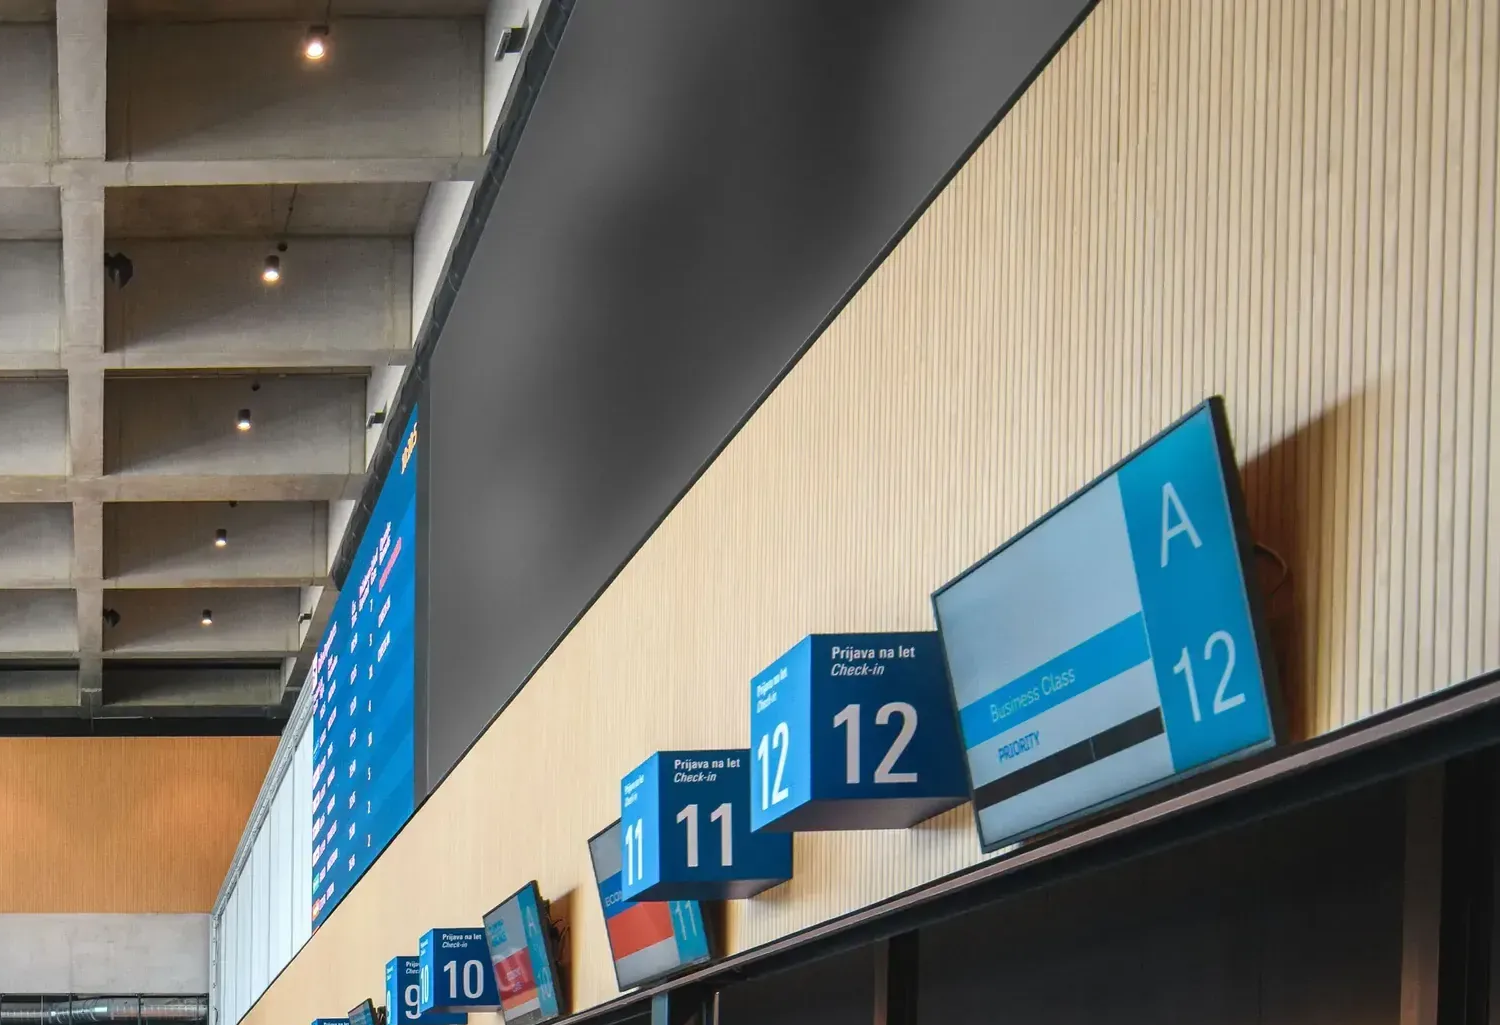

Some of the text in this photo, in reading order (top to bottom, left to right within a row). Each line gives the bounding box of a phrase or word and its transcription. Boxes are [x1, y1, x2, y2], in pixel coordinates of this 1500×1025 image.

[1159, 481, 1203, 568] A
[830, 662, 885, 677] Check-in
[831, 646, 916, 662] Prijava na let
[990, 665, 1076, 722] Business Class
[1173, 629, 1246, 722] 12
[832, 701, 918, 784] 12
[997, 729, 1040, 763] PRIORITY
[673, 772, 717, 783] Check-in
[674, 758, 741, 771] Prijava na let
[757, 721, 790, 811] 12
[625, 818, 643, 886] 11
[676, 802, 733, 868] 11
[604, 890, 622, 907] ECO
[442, 933, 463, 942] Prijava
[473, 933, 482, 941] let
[675, 900, 697, 941] 11
[442, 941, 468, 949] Check-in
[420, 964, 429, 1005] 10
[443, 959, 484, 999] 10
[405, 984, 421, 1020] 9
